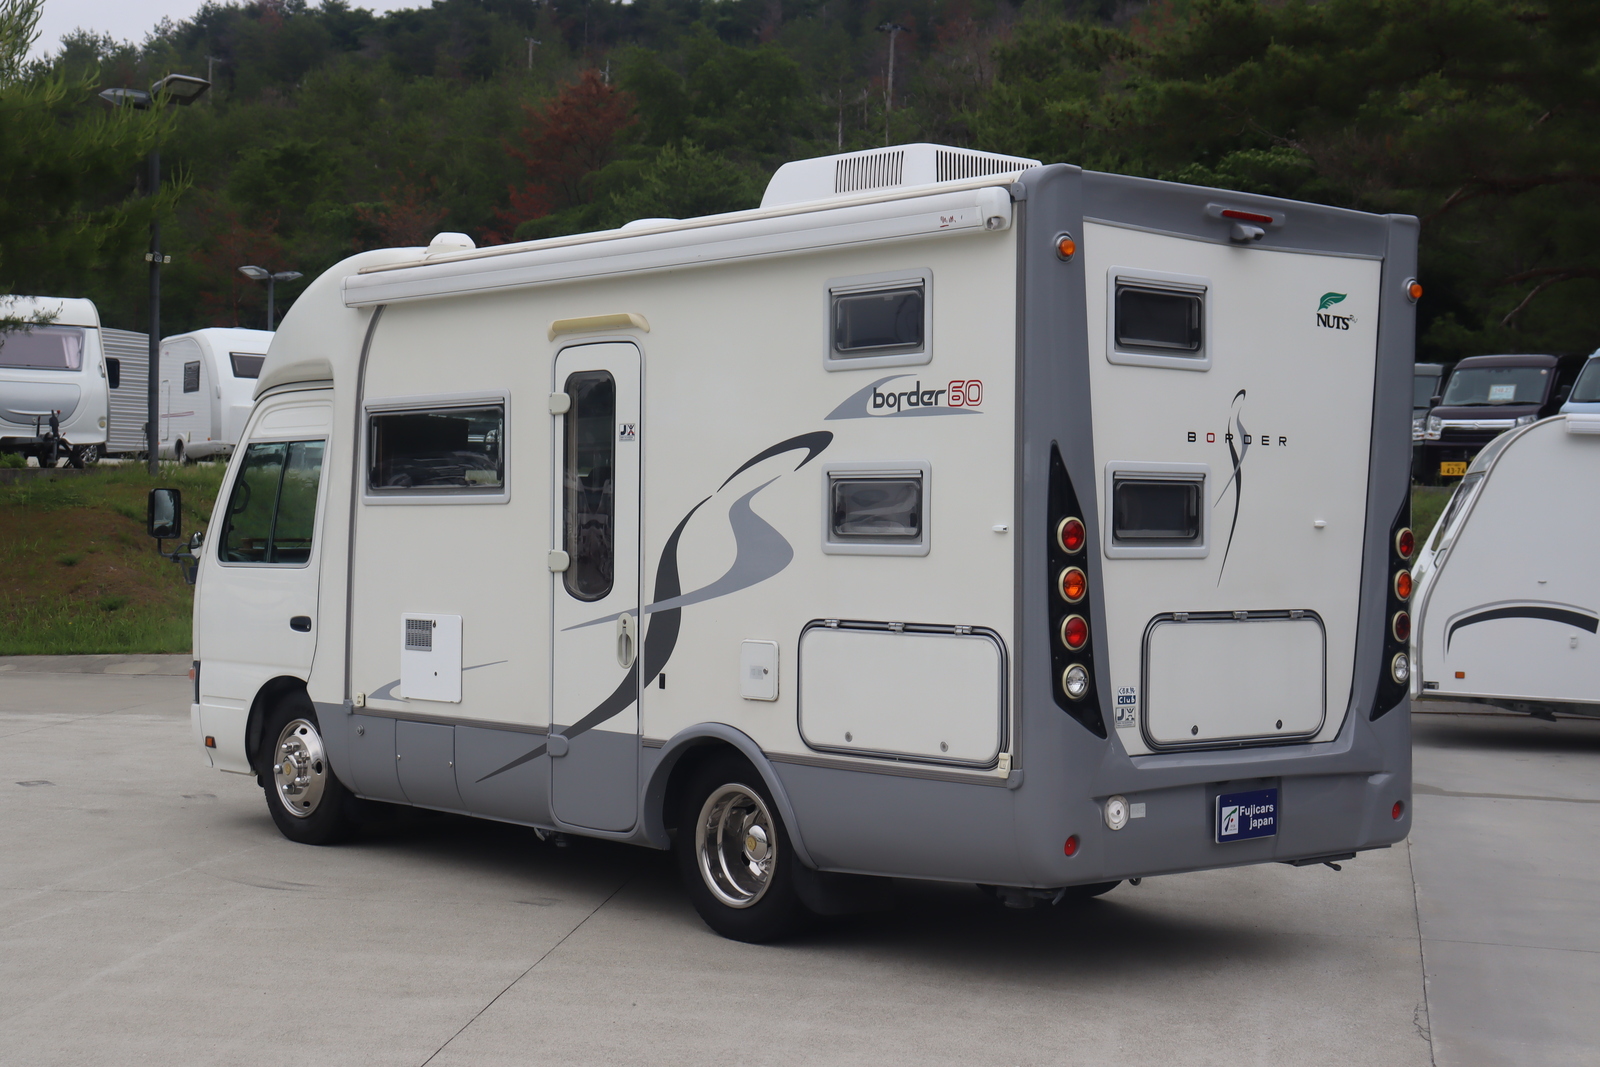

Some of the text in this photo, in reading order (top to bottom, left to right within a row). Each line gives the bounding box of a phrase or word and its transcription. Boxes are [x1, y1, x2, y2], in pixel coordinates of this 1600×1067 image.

[1316, 312, 1350, 330] NUTS
[1187, 431, 1288, 447] BORDER
[1118, 695, 1136, 704] Club
[1239, 804, 1274, 817] Fujicars
[1249, 816, 1274, 830] japan
